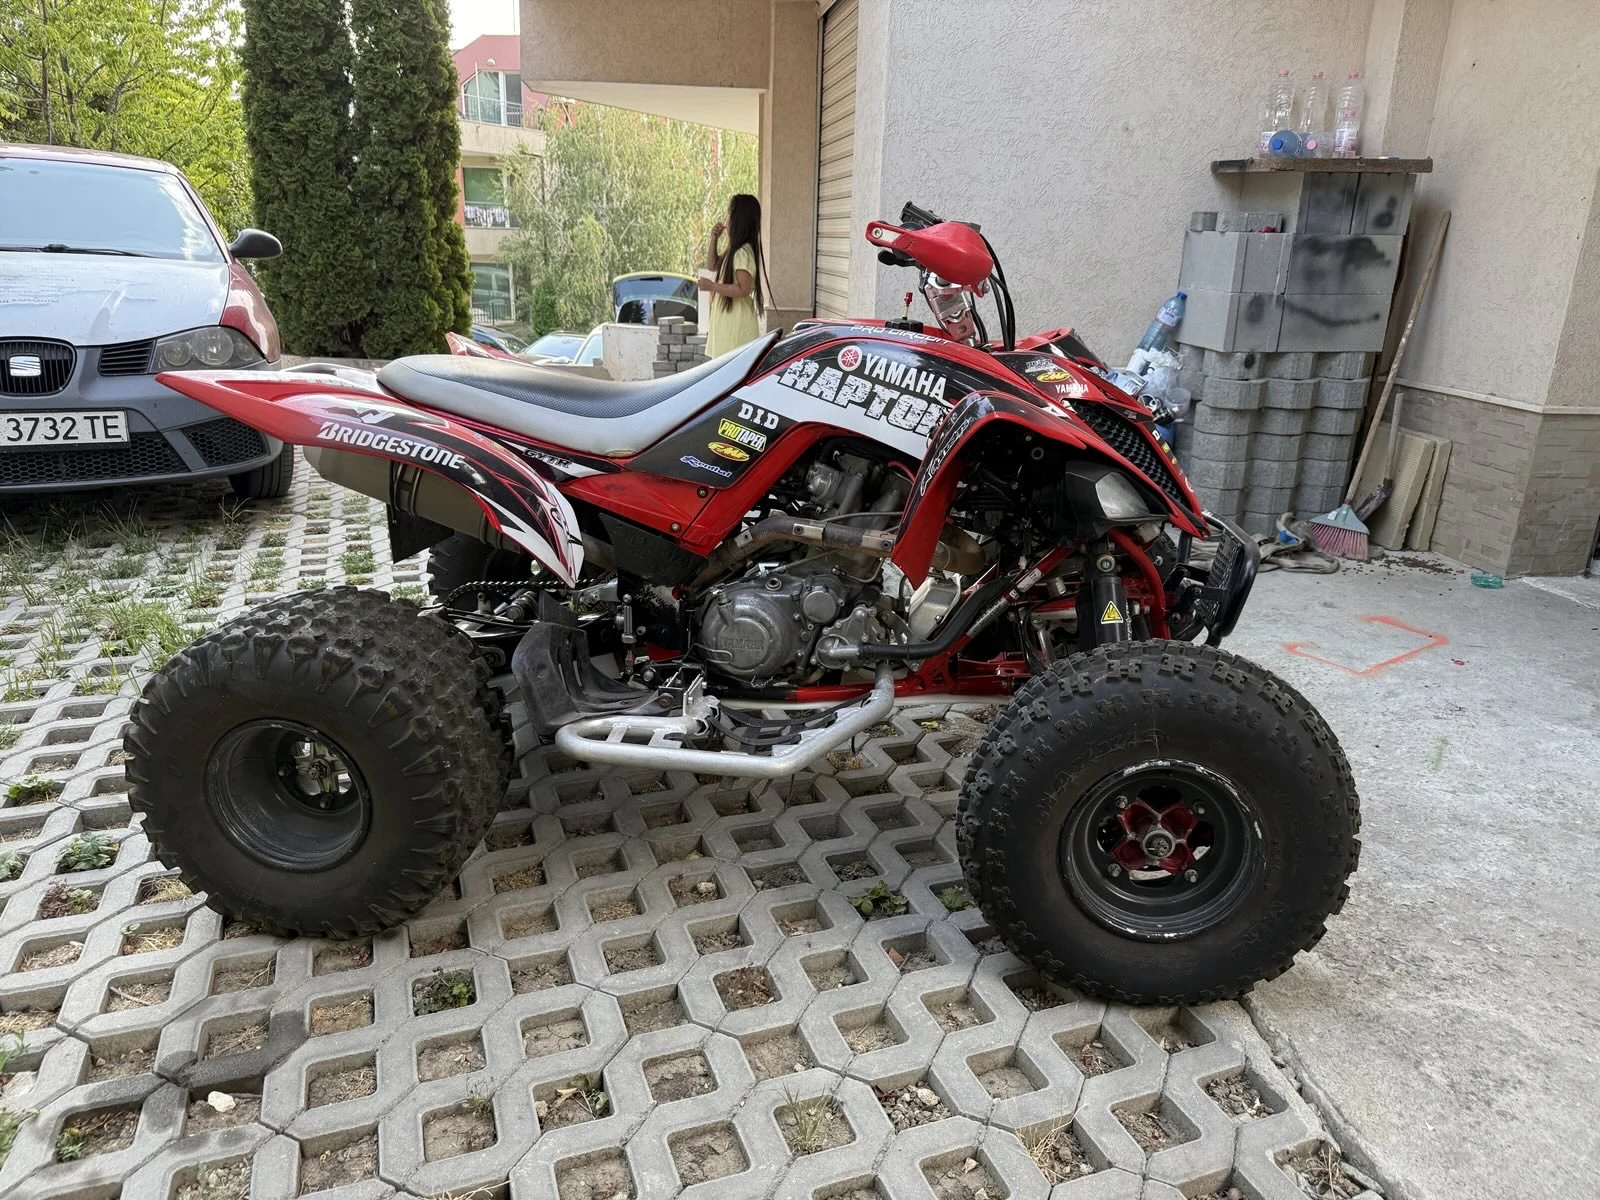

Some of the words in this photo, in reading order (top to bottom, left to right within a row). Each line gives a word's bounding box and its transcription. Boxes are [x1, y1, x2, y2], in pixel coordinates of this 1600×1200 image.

[863, 353, 947, 400] YAMAHA
[6, 416, 79, 441] 3732
[83, 415, 122, 439] TE
[737, 402, 779, 430] D.I.D
[316, 421, 466, 470] BRIDGESTONE
